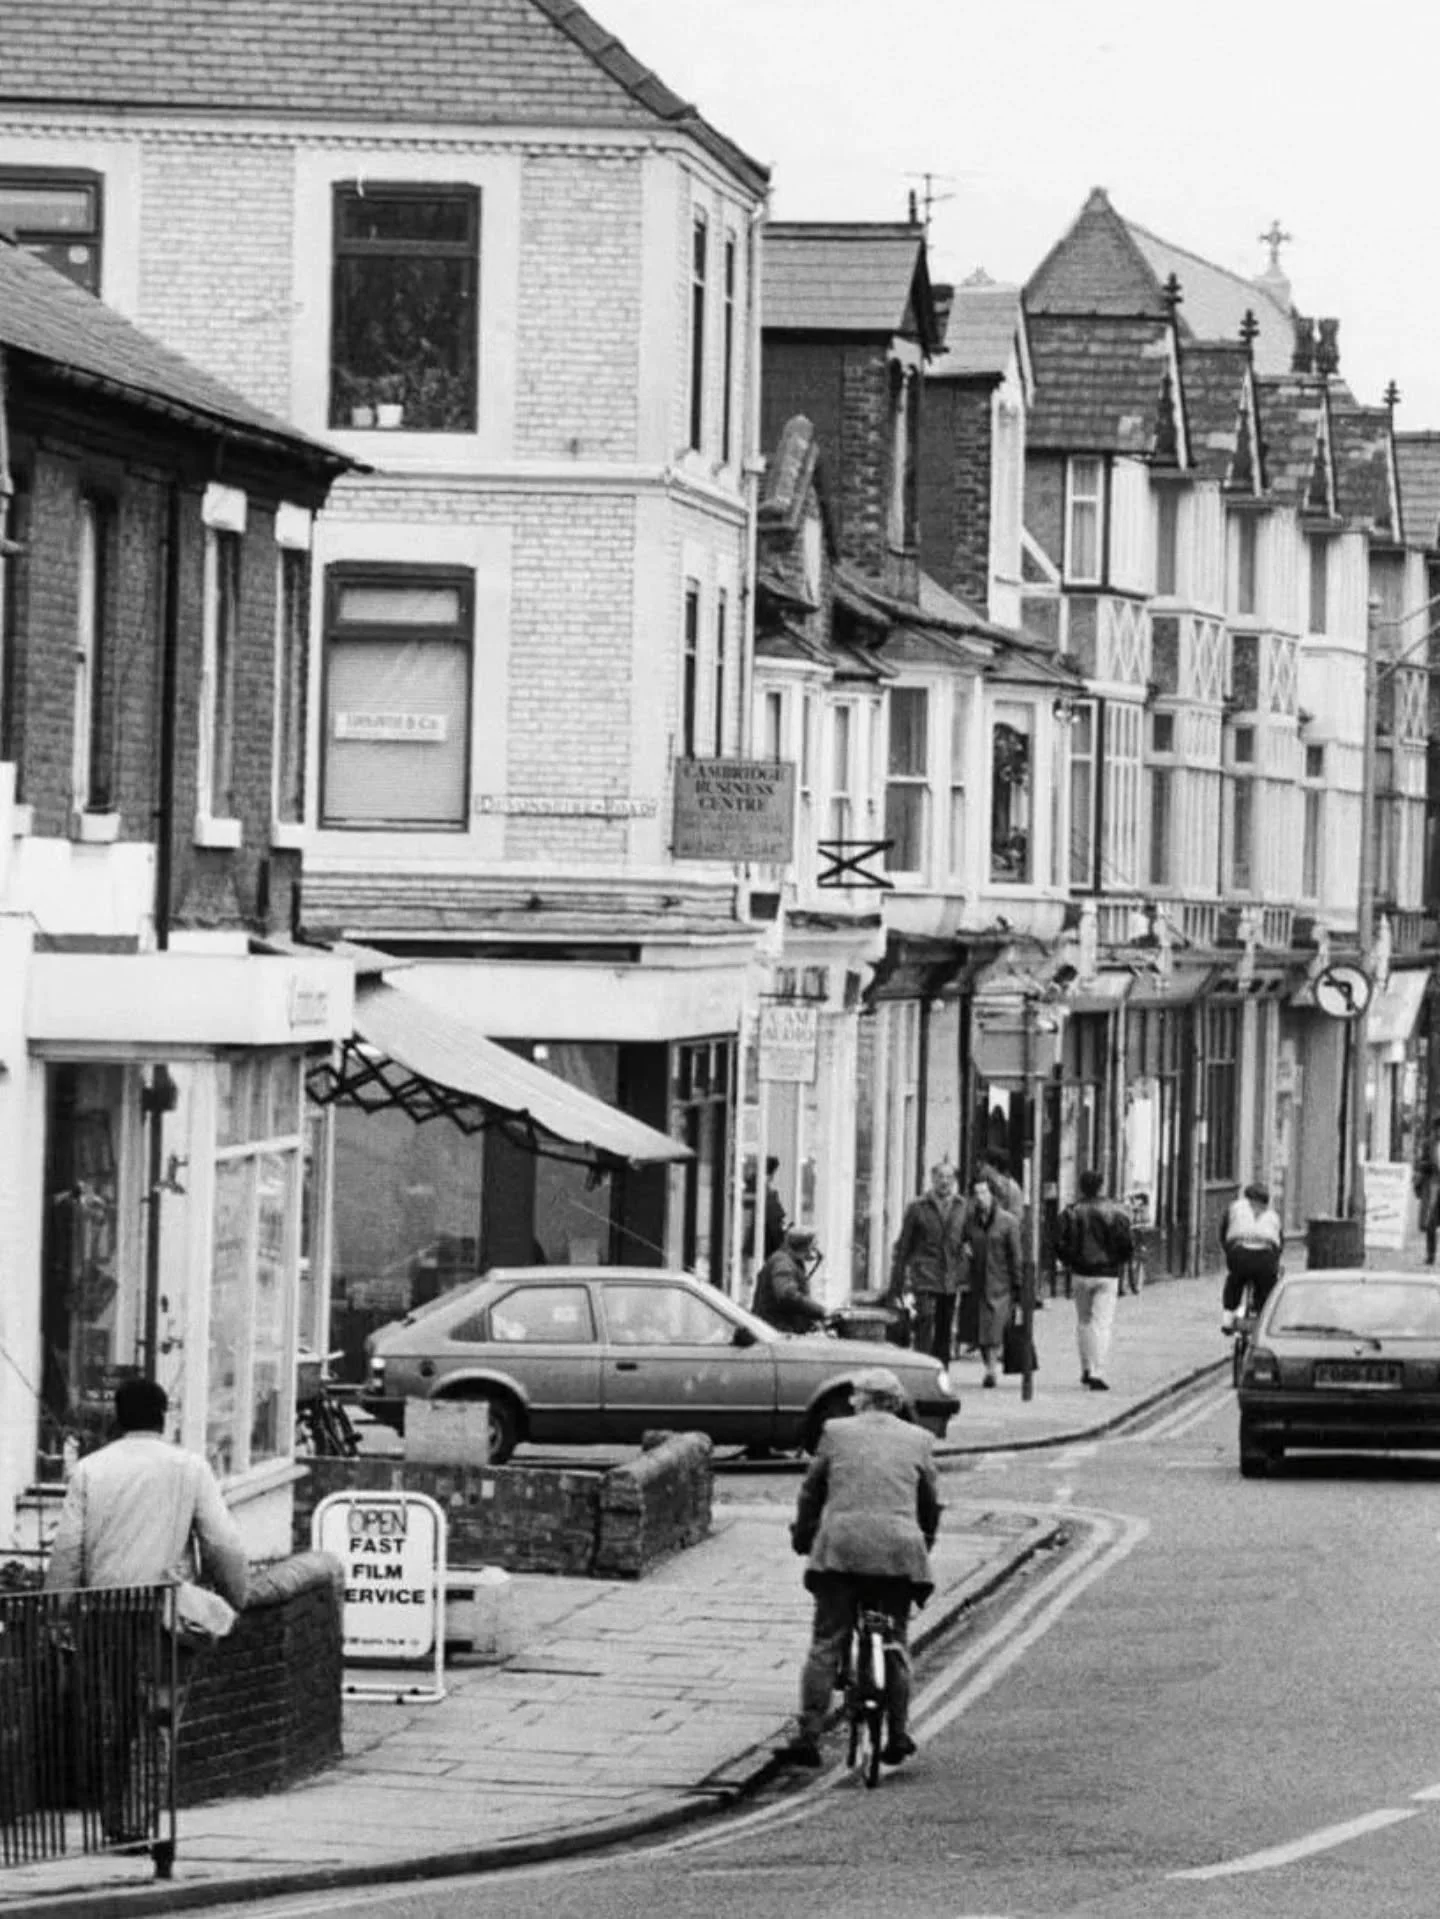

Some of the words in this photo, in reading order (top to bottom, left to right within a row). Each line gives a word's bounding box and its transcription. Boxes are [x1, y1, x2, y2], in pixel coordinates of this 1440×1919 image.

[682, 765, 780, 780] CAMBRIDGE
[695, 779, 774, 795] BUSINESS
[698, 796, 765, 811] CENTRE
[347, 1509, 407, 1535] OPEN
[350, 1537, 405, 1554] FAST
[352, 1564, 403, 1580] FILM
[344, 1588, 425, 1604] ERVICE
